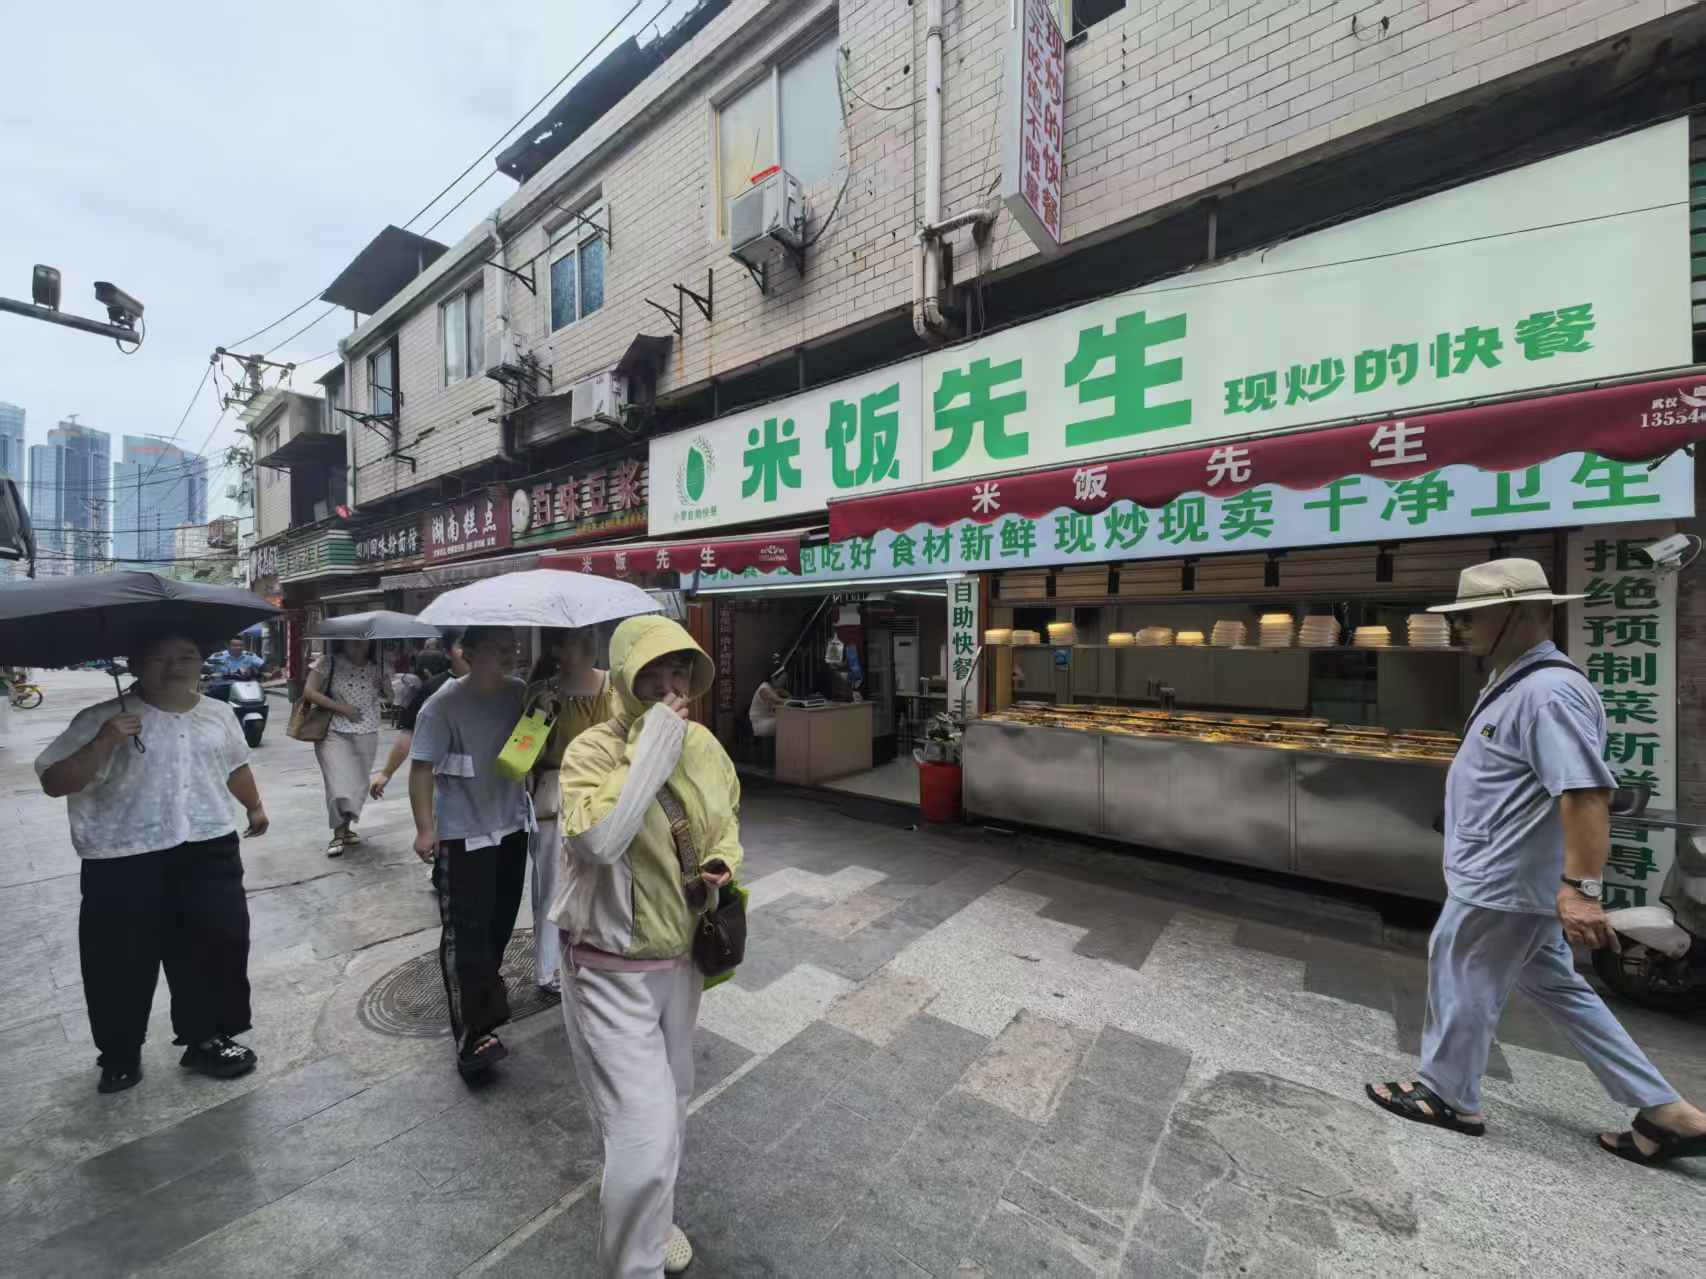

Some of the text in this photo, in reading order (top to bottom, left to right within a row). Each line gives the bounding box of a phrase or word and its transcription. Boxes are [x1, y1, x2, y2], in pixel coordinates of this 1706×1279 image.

[742, 302, 1597, 502] 米饭先生 现炒的快餐
[888, 518, 1037, 568] 食材新鲜
[1053, 488, 1275, 554] 现炒现卖
[1304, 452, 1661, 533] 干净卫生
[971, 421, 1428, 514] 米饭先生
[581, 546, 717, 575] 米饭先生
[952, 582, 975, 681] 自助快餐
